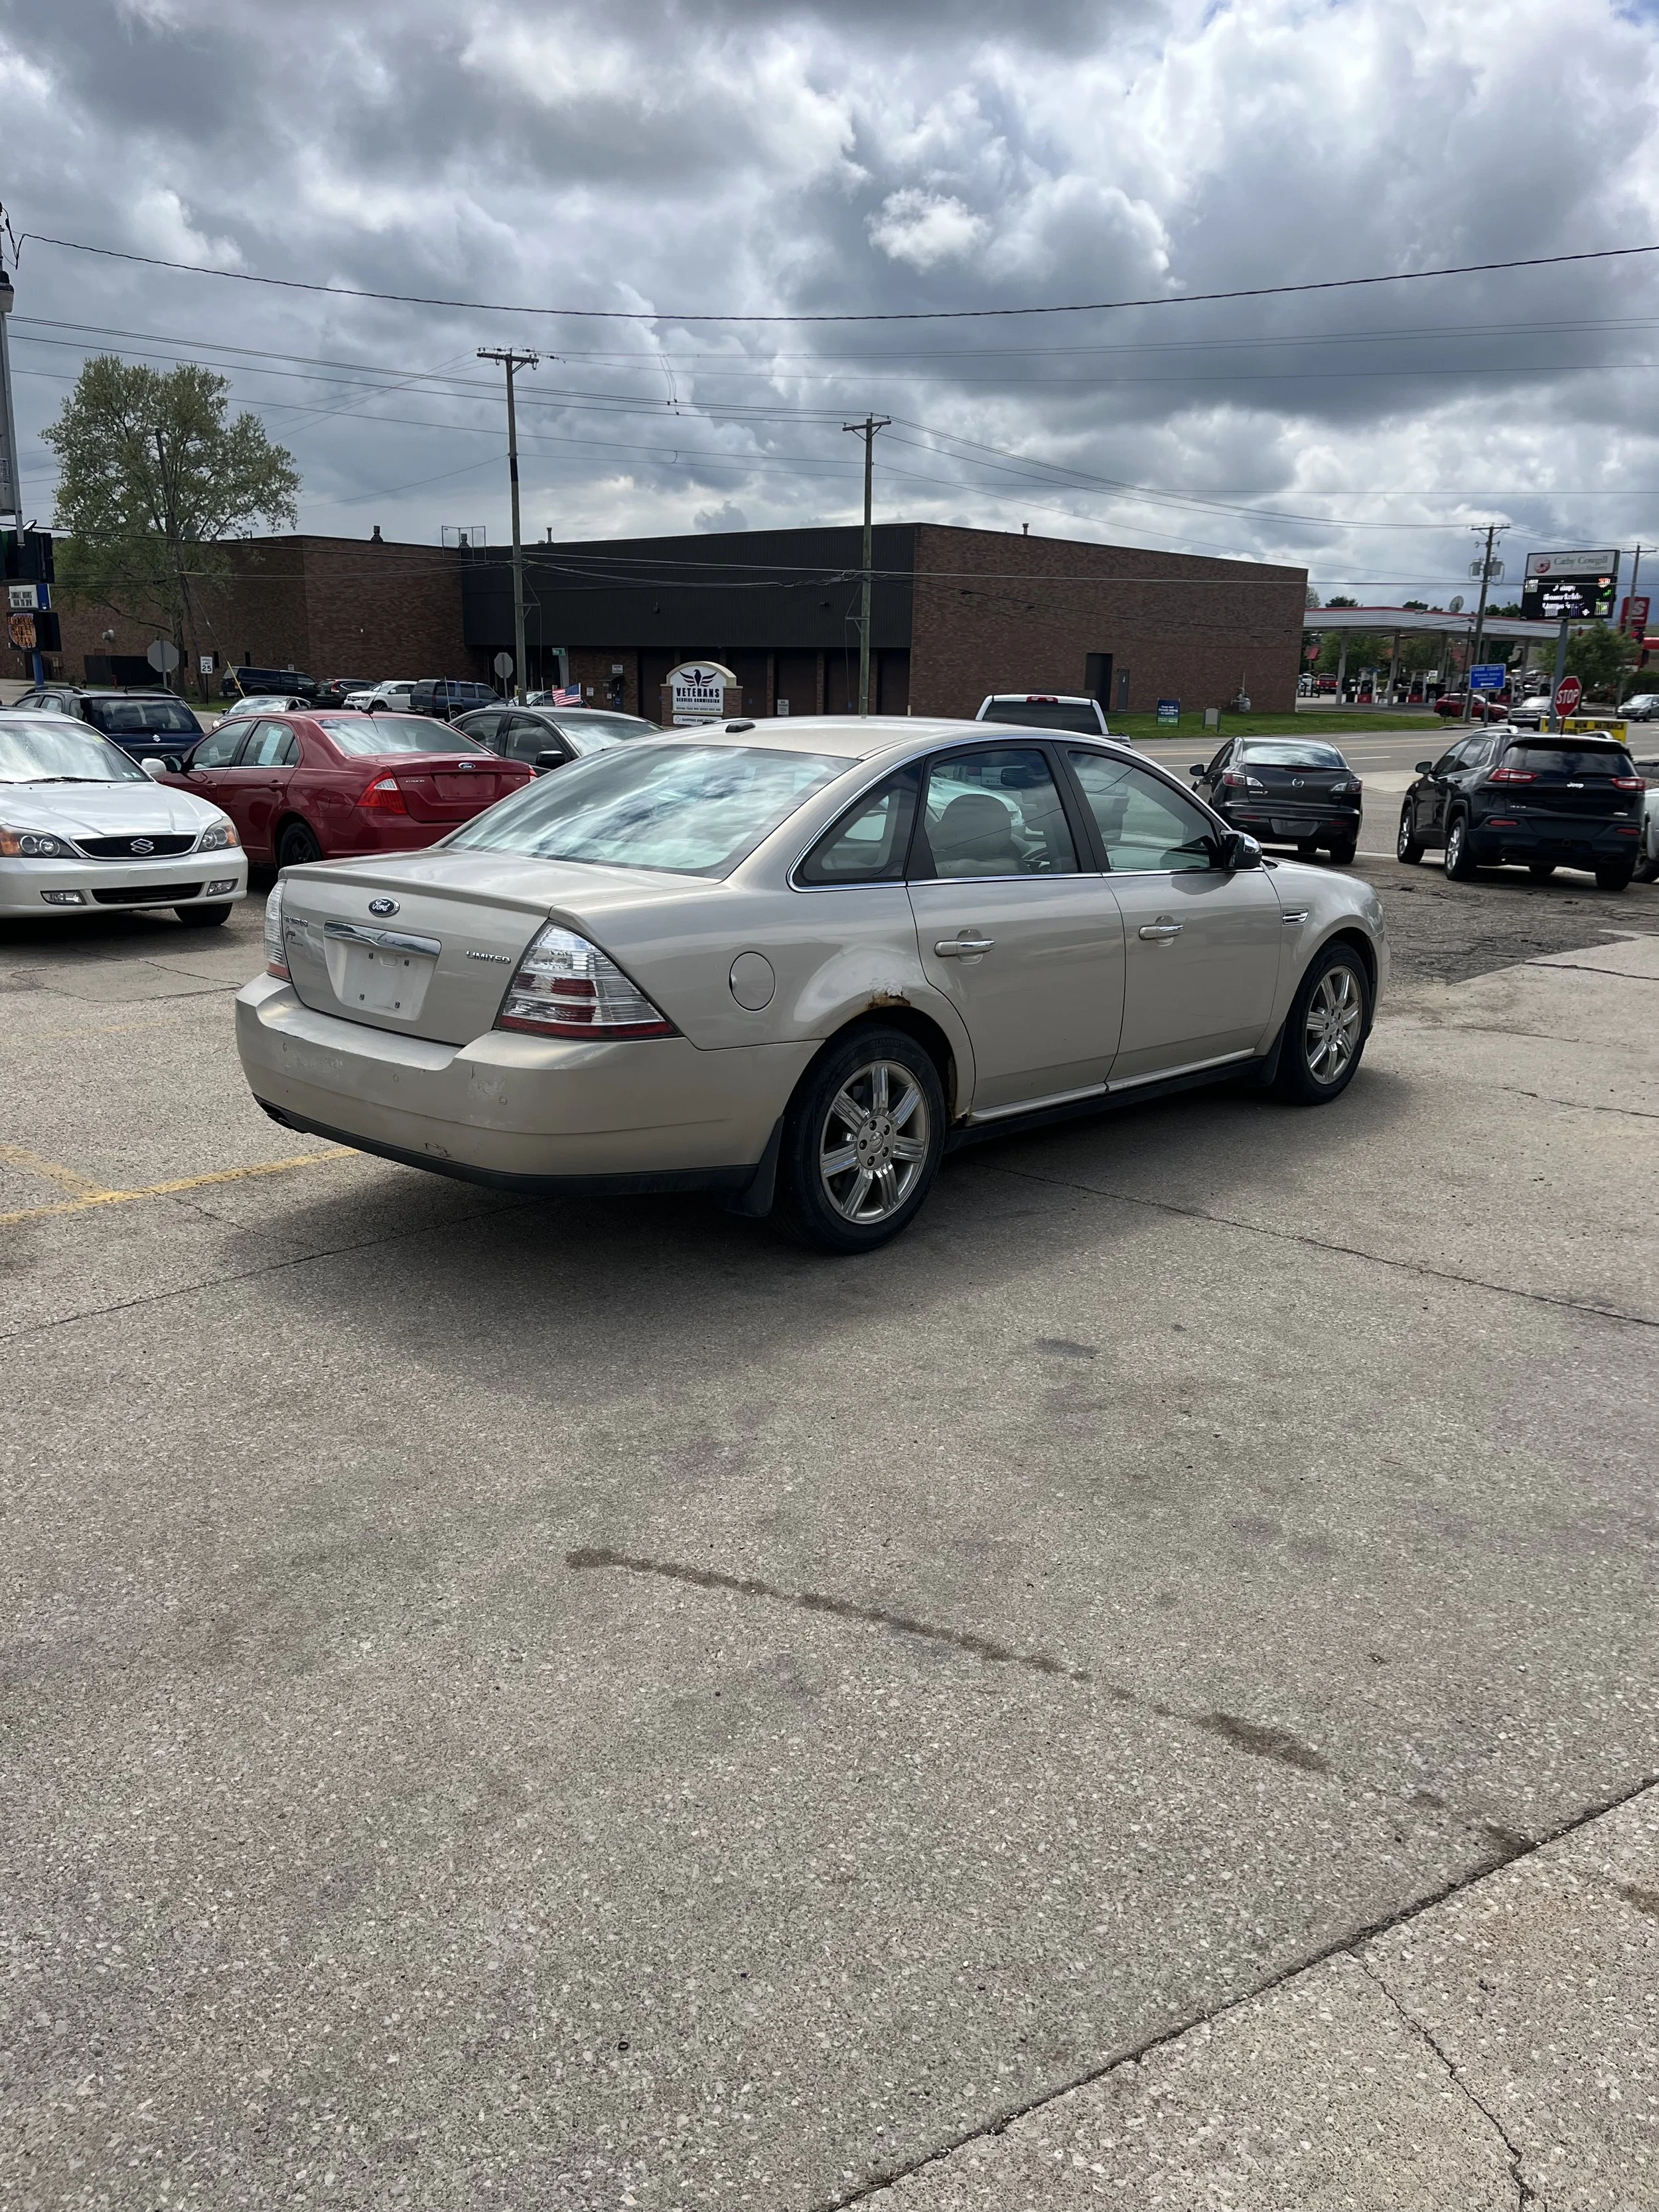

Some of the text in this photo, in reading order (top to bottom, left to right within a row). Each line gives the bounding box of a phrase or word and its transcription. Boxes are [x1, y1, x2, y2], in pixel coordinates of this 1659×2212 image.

[676, 688, 719, 698] VETERANS
[1556, 689, 1579, 704] STOP
[372, 899, 391, 912] Ford
[466, 950, 512, 964] LIMITED
[869, 1039, 906, 1049] SUMMIT
